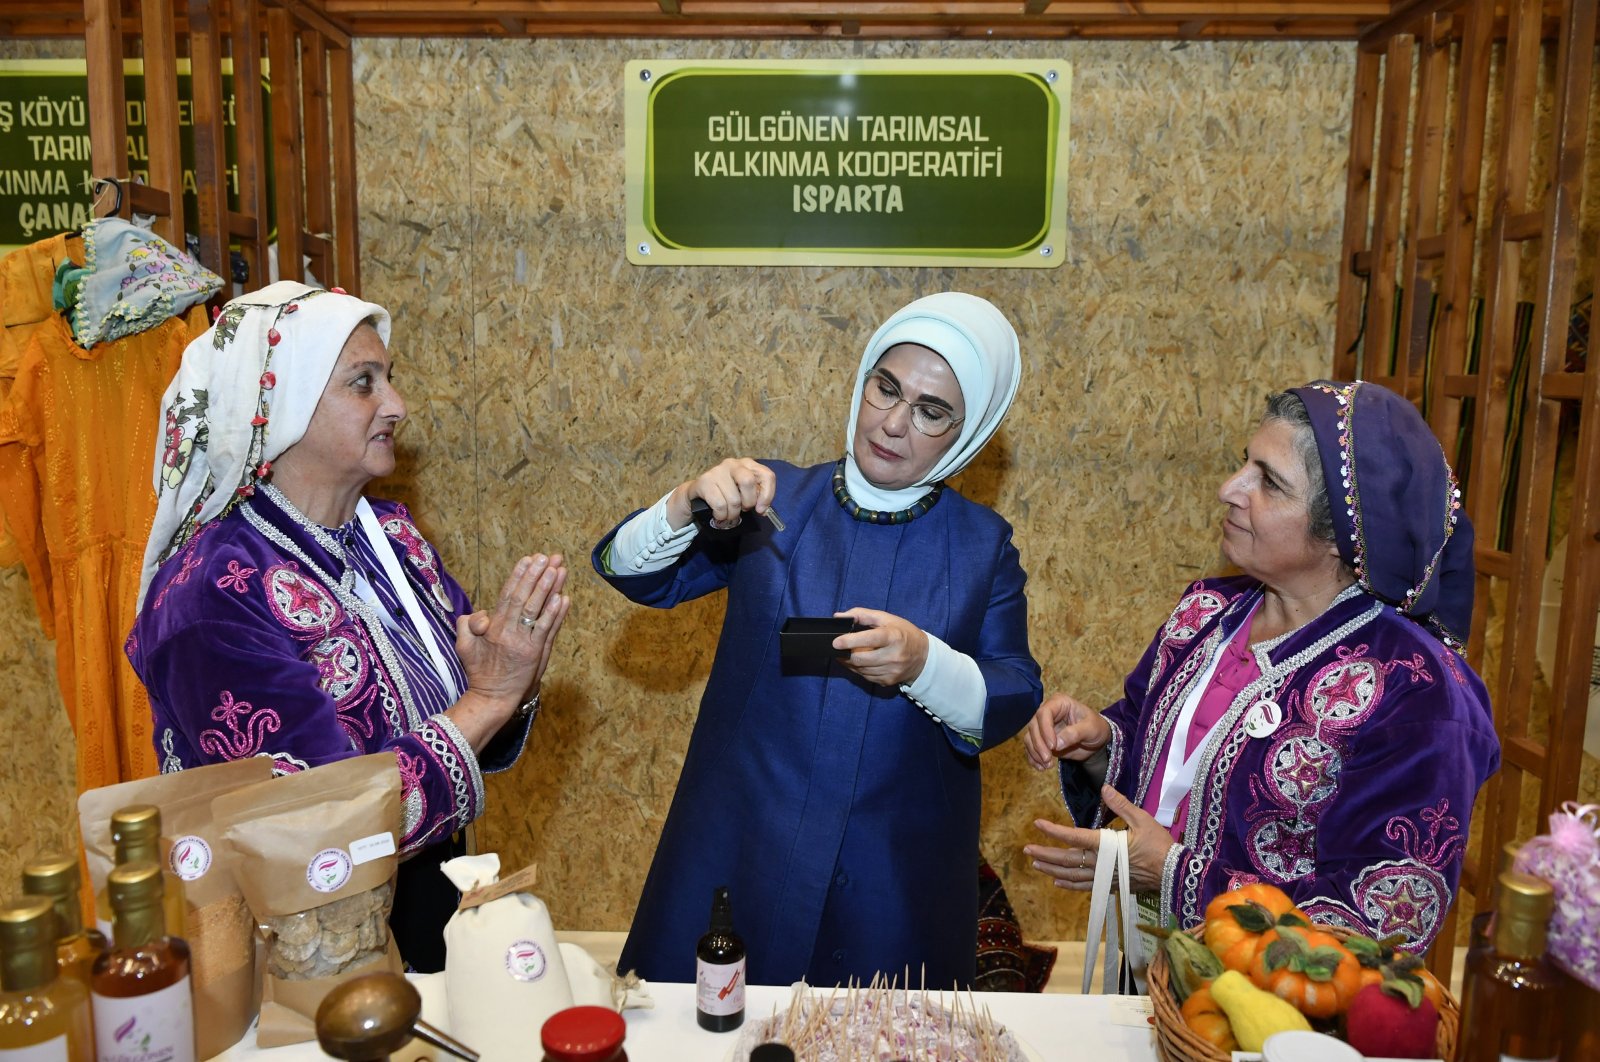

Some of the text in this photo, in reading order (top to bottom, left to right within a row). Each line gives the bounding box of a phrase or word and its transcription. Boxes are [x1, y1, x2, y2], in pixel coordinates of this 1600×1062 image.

[20, 96, 86, 127] KÖYÜ
[708, 110, 990, 142] GÜLGÖNEN TARIMSAL
[694, 146, 1003, 177] KALKINMA KOOPERATİFİ
[793, 184, 904, 214] ISPARTA
